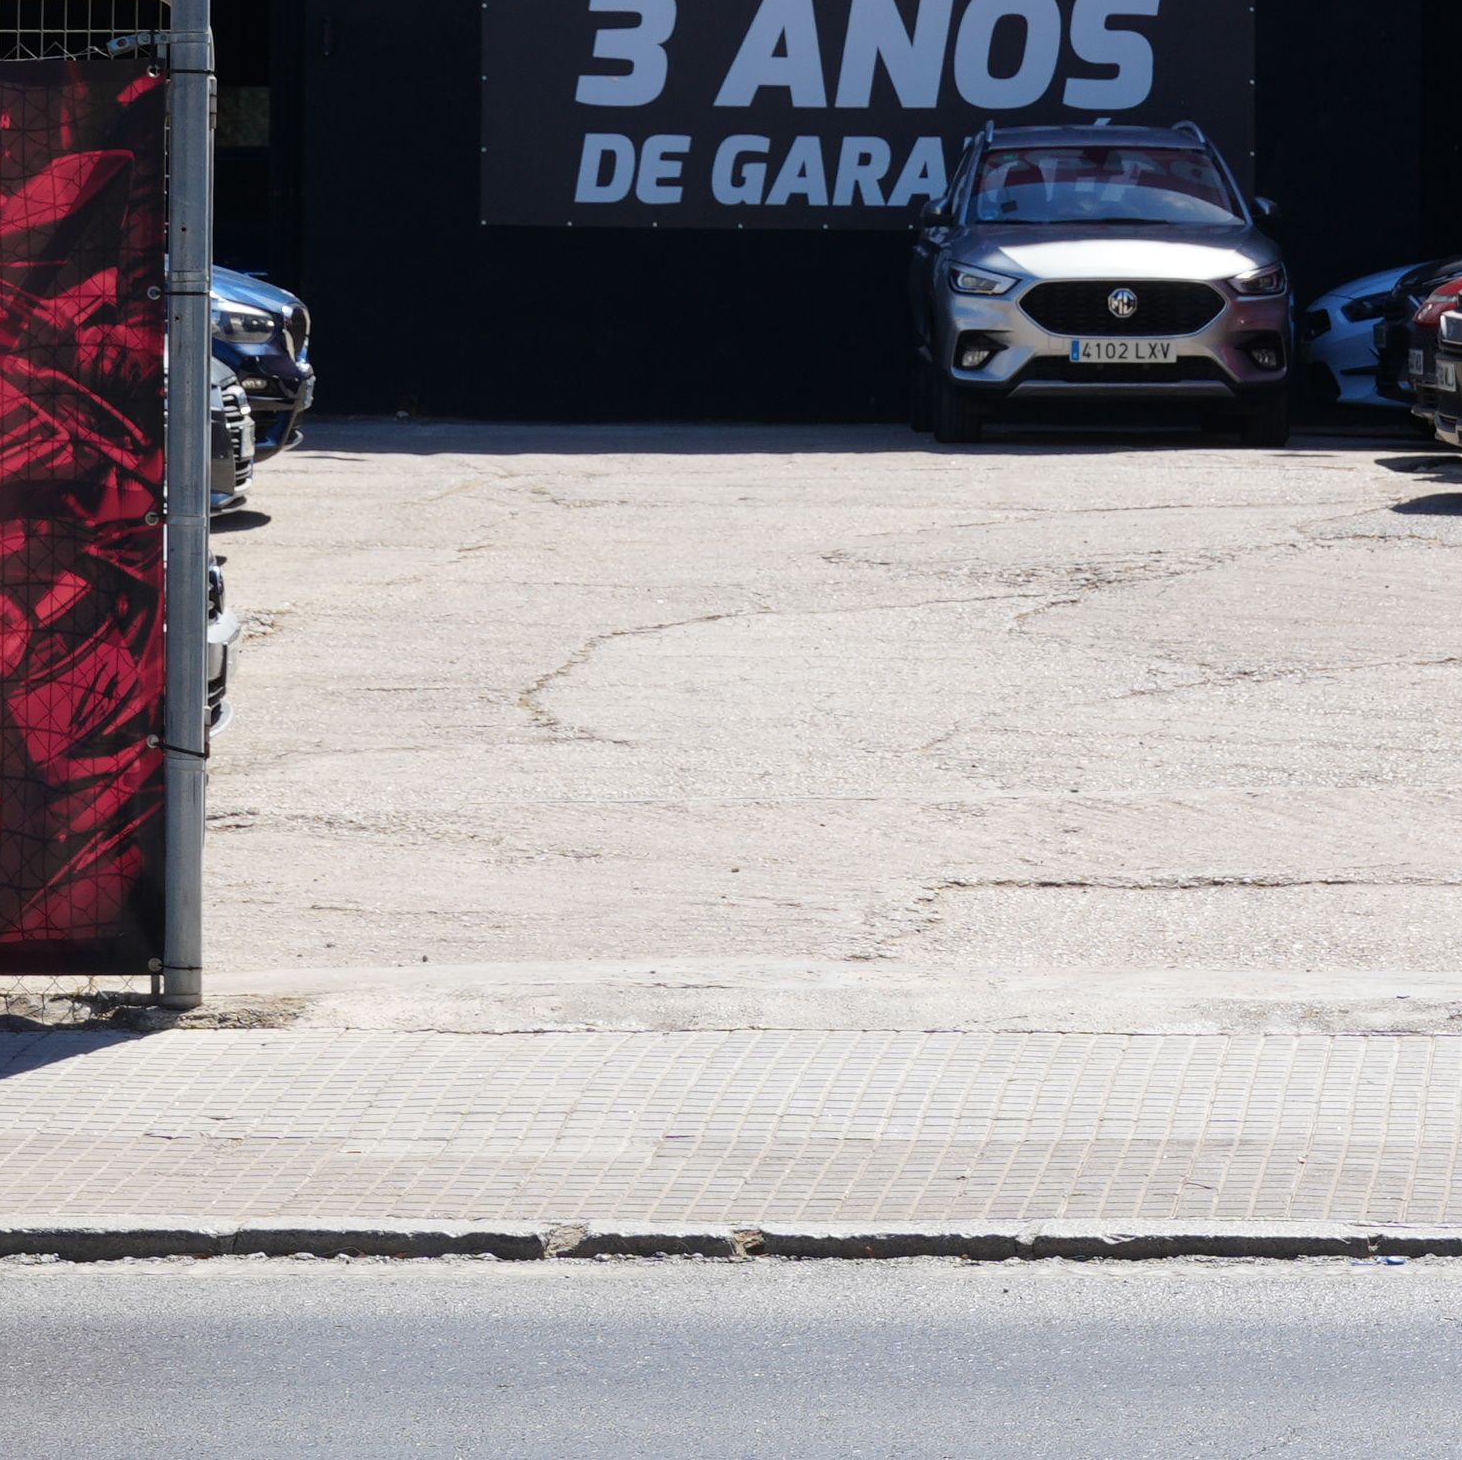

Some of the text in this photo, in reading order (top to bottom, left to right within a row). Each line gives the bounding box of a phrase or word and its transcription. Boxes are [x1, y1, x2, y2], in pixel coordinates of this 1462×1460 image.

[573, 132, 971, 207] DE GARA
[1082, 342, 1171, 360] 4102 LXV
